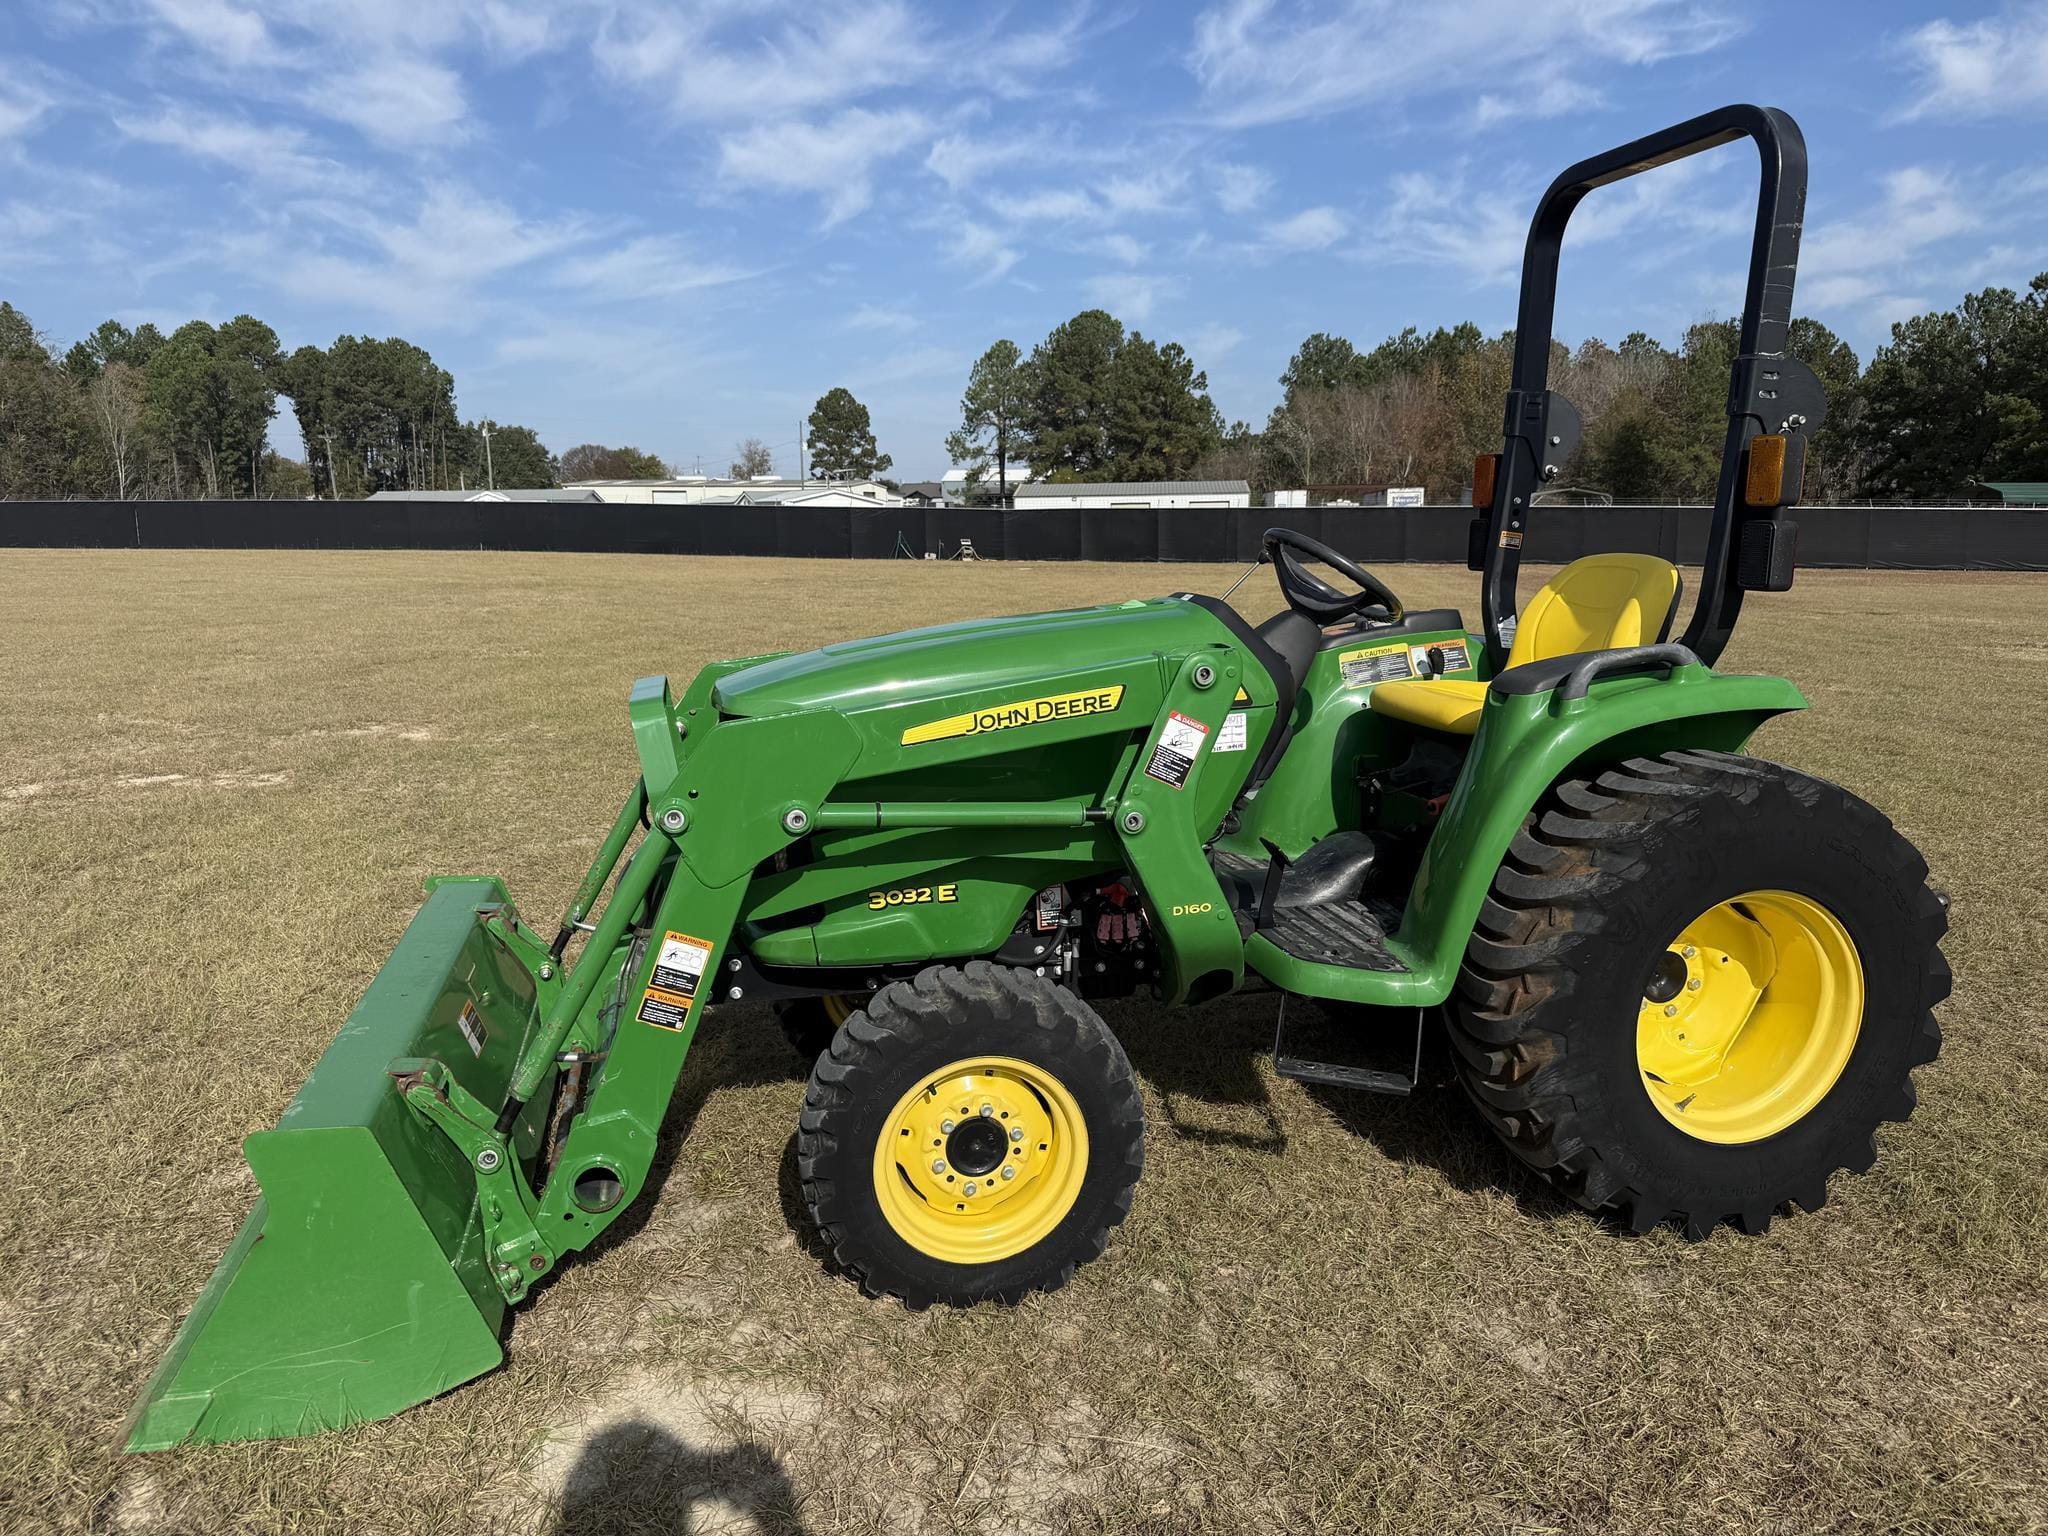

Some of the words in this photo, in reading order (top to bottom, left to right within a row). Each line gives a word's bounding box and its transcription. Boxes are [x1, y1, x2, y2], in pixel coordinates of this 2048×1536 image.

[1364, 648, 1392, 658] CAUTION
[966, 707, 1030, 733] JOHN
[1036, 693, 1112, 720] DEERE
[1181, 717, 1205, 731] DANGER
[868, 887, 932, 910] 3032
[938, 884, 957, 902] E
[1172, 903, 1212, 916] D160
[677, 935, 708, 948] WARNING
[657, 995, 688, 1007] WARNING
